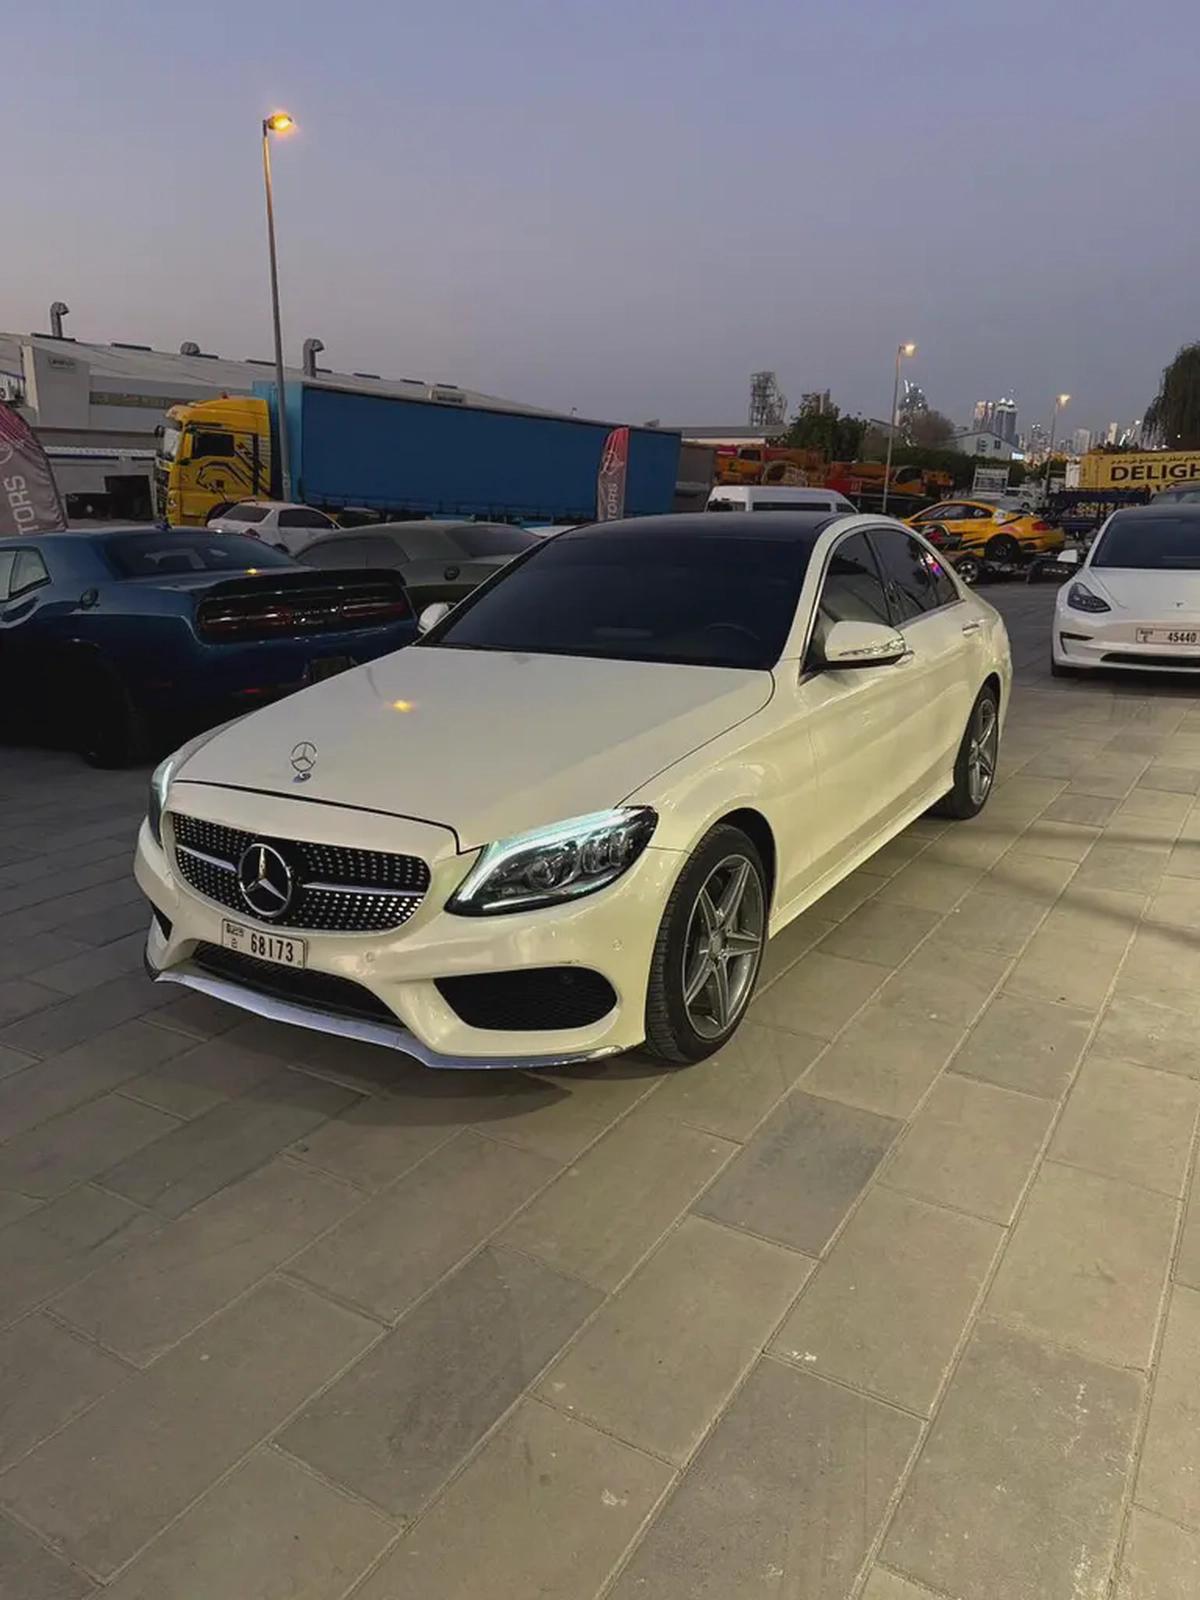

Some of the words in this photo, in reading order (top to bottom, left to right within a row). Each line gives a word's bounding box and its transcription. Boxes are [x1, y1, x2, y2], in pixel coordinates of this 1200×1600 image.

[3, 475, 39, 535] TORS
[1167, 632, 1197, 643] 45440
[250, 933, 294, 962] 68173
